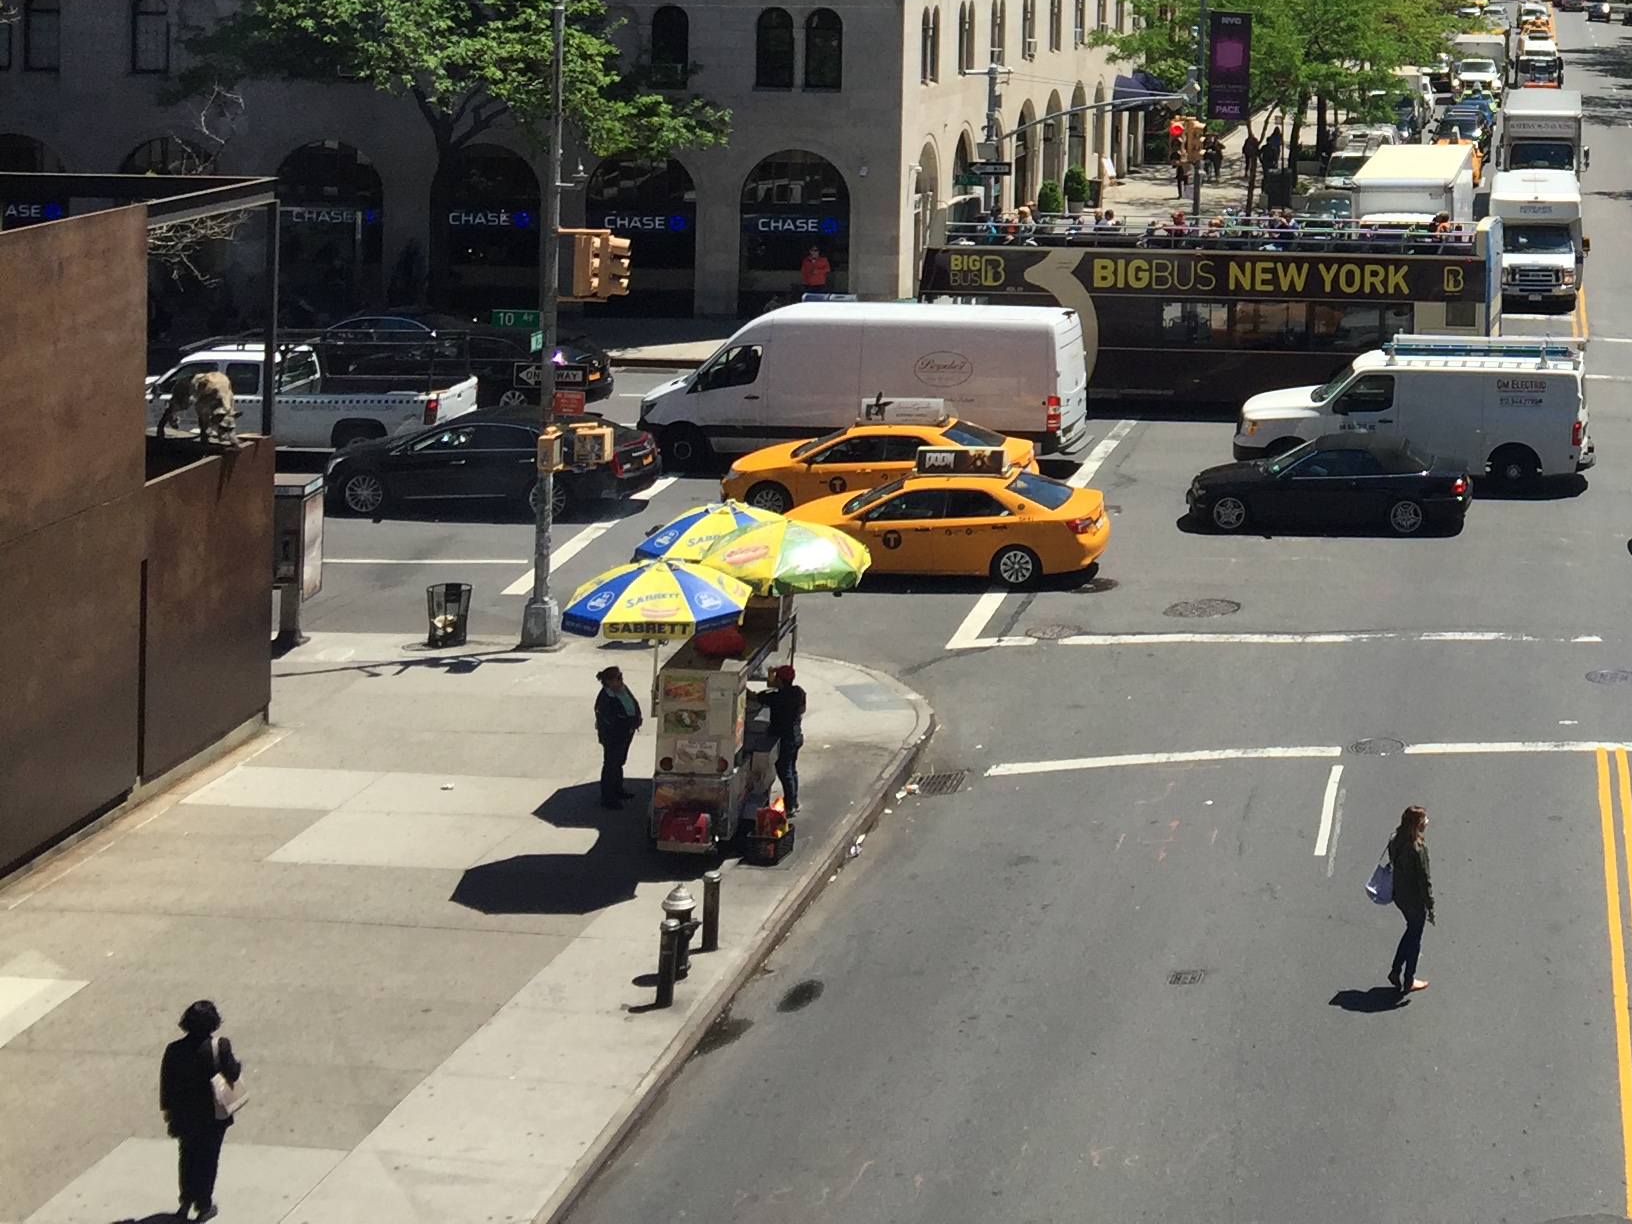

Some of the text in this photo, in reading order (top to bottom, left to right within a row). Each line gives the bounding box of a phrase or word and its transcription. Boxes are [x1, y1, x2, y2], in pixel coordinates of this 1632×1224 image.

[1215, 105, 1241, 114] PACE
[4, 203, 42, 218] ASE
[292, 208, 355, 223] CHASE
[448, 211, 511, 226] CHASE
[603, 215, 666, 230] CHASE
[757, 217, 819, 232] CHASE
[950, 254, 981, 271] BIG
[950, 271, 981, 286] BUS
[1228, 261, 1310, 292] NEW
[1318, 262, 1411, 295] YORK
[498, 312, 515, 326] 10
[525, 370, 541, 381] ON
[1511, 378, 1547, 390] ELECTRIC
[924, 451, 956, 470] DOOM
[687, 533, 720, 547] SABR
[626, 591, 681, 609] SABRETT
[608, 621, 691, 636] SABRETT
